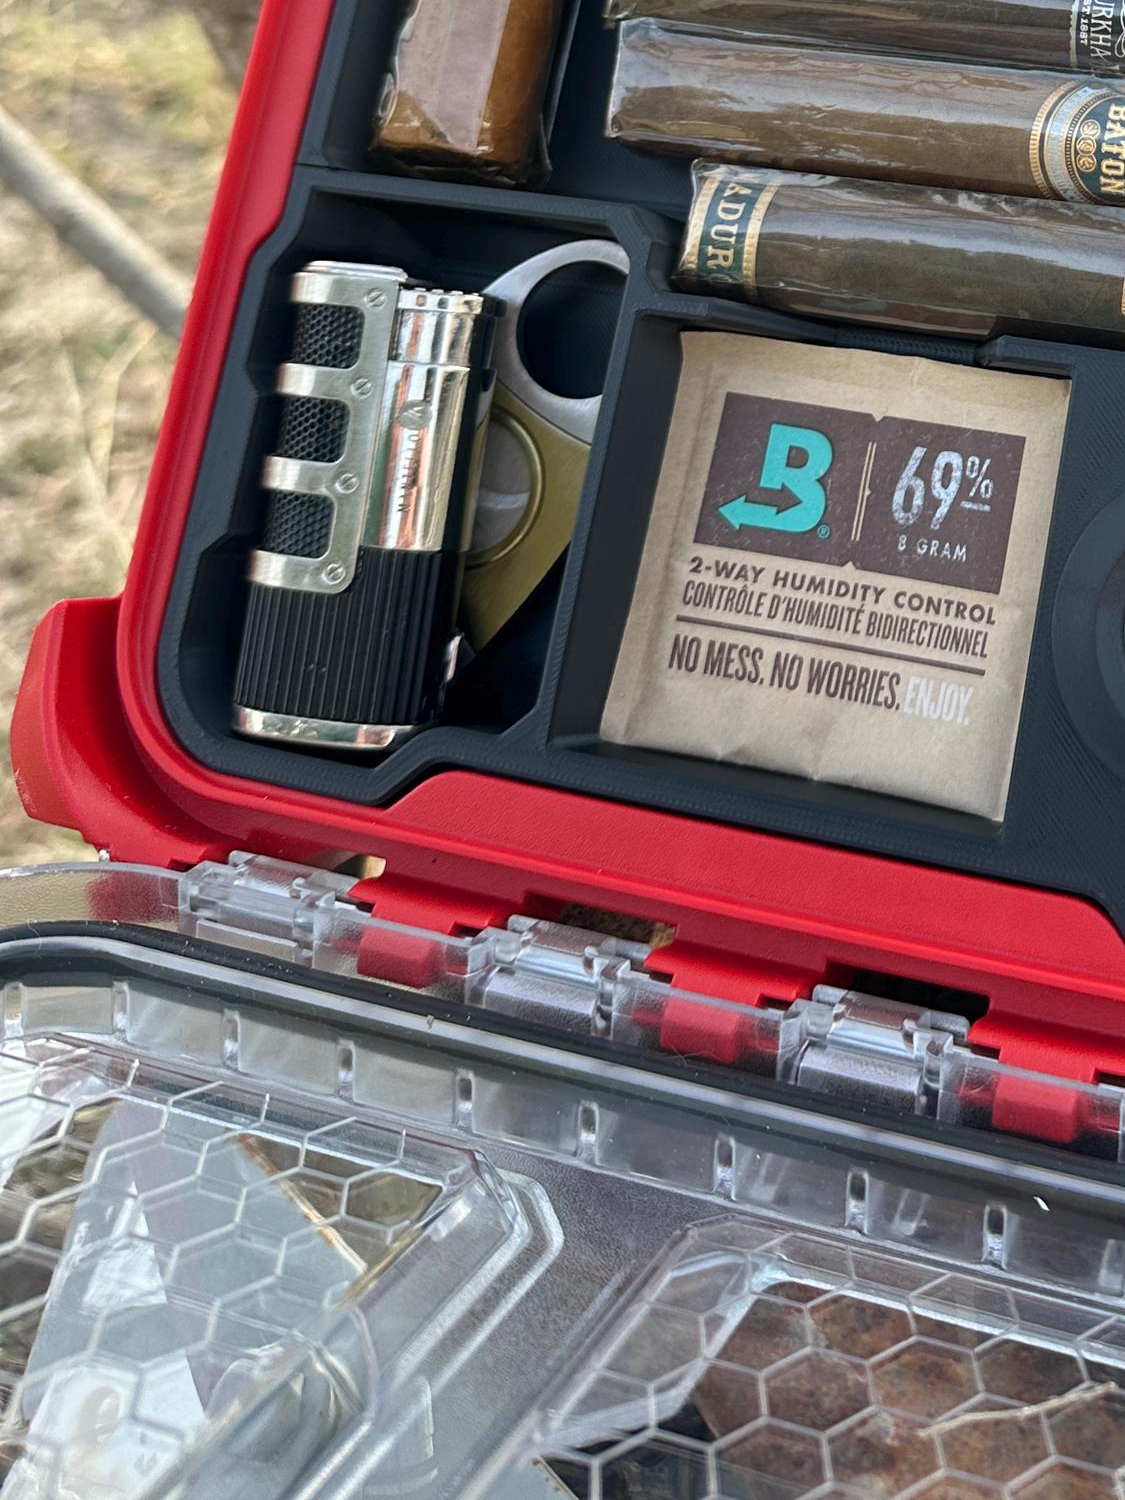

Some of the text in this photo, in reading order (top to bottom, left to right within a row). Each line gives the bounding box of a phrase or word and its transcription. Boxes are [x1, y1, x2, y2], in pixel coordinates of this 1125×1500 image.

[707, 183, 752, 285] ADURO
[916, 537, 967, 562] GRAM
[682, 579, 768, 617] CONTRÔLE
[865, 610, 989, 659] BIDIRECTIONNEL
[689, 555, 996, 625] 2-WAY HUMIDITY CONTROL
[669, 633, 974, 725] NO MESS. NO WORRIES. ENJOY.
